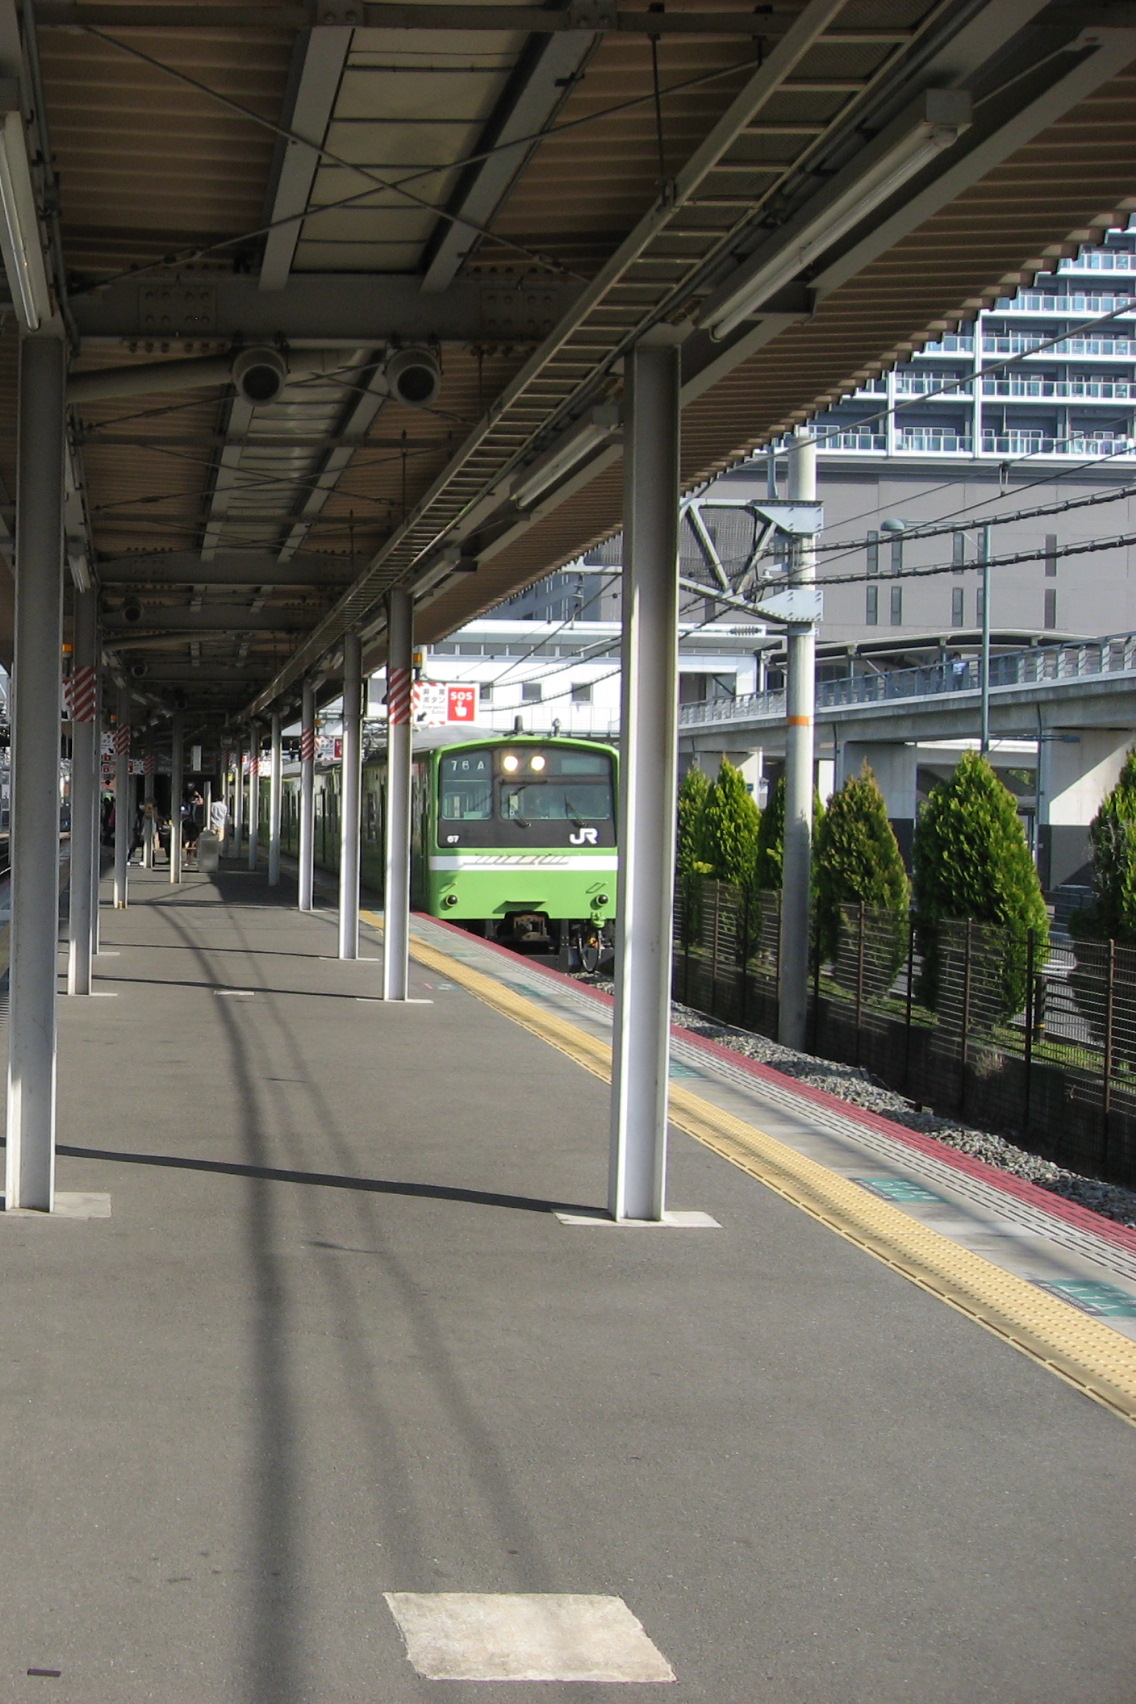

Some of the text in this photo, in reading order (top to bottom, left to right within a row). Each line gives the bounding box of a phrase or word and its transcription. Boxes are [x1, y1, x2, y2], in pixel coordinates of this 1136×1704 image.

[450, 691, 473, 700] SOS
[446, 835, 460, 844] 67
[569, 827, 598, 845] JR
